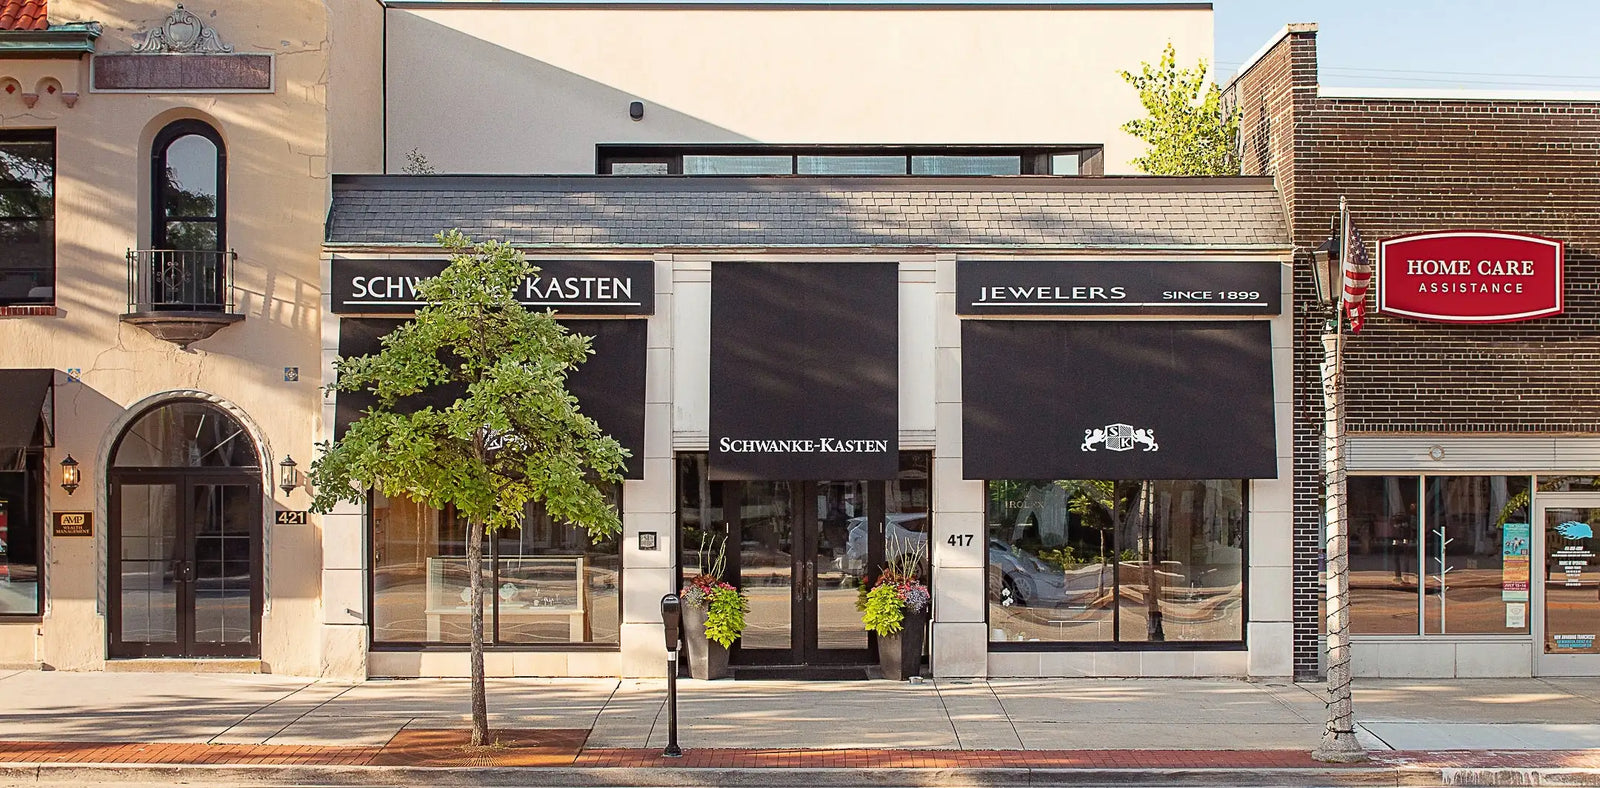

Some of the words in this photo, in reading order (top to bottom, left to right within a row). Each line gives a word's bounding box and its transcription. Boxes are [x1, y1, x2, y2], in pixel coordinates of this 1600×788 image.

[1407, 260, 1471, 275] HOME
[1477, 260, 1535, 275] CARE
[352, 276, 632, 299] SCHW-KASTEN
[979, 286, 1127, 301] JEWELERS
[1162, 291, 1212, 300] SINCE
[1218, 291, 1260, 300] 1899
[1419, 283, 1523, 293] ASSISTANCE
[1109, 427, 1118, 436] S
[719, 437, 889, 453] SCHWANKE-KASTEN
[1121, 438, 1130, 447] K
[1009, 500, 1044, 509] ROLX
[63, 515, 83, 524] AMP
[278, 511, 304, 524] 421
[947, 534, 974, 547] 417
